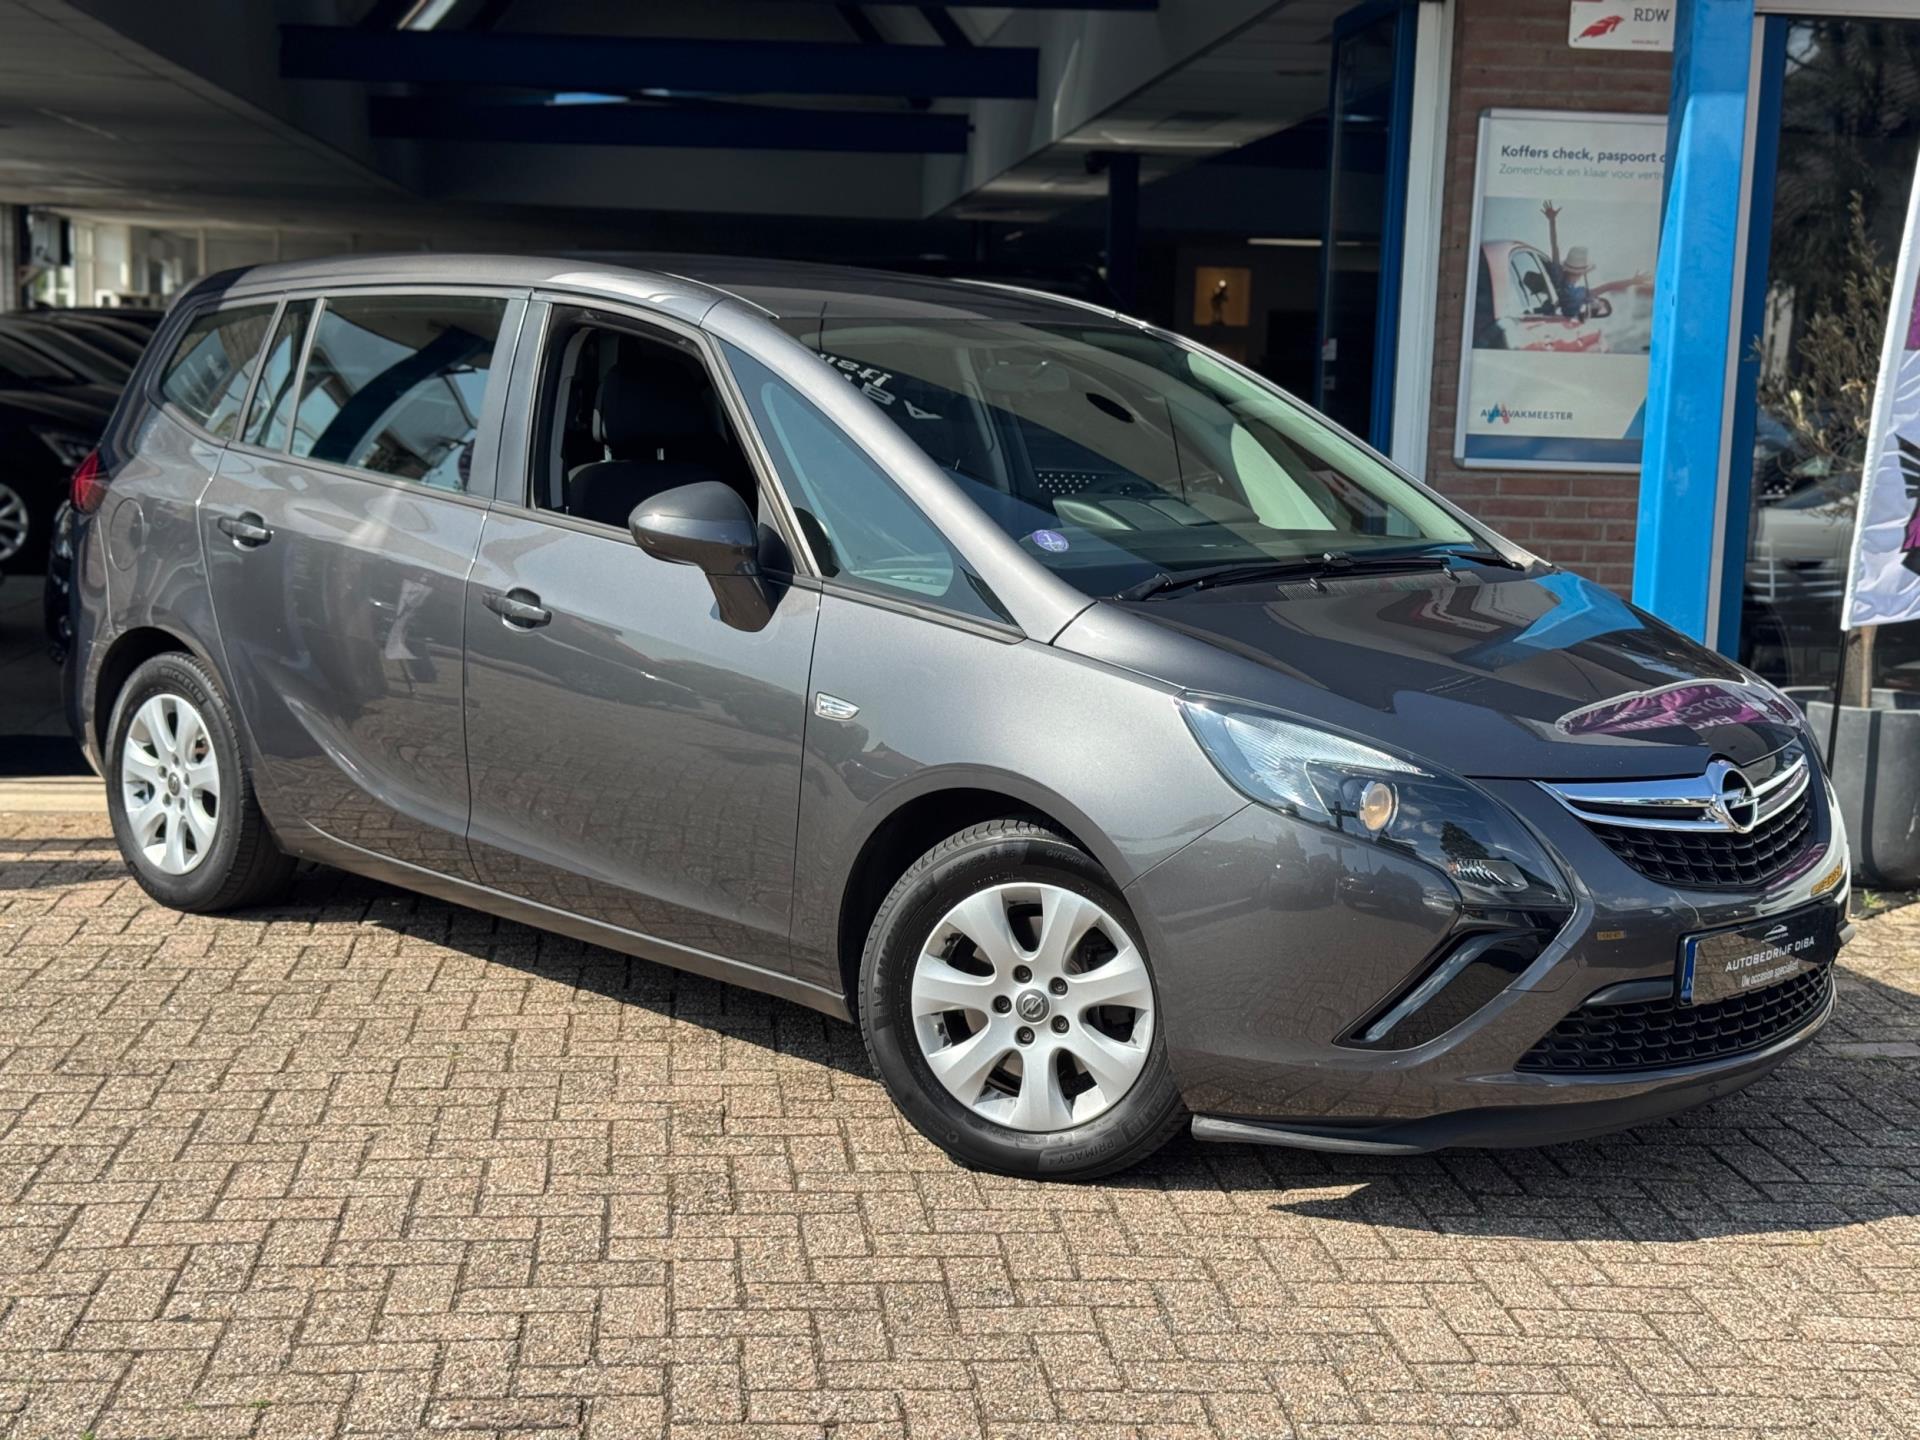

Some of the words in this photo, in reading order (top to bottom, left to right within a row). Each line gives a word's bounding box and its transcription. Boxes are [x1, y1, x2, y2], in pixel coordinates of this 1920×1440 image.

[1633, 8, 1670, 22] RDW
[1501, 145, 1549, 159] Koffers
[1552, 147, 1594, 162] check,
[1597, 151, 1657, 164] paspoort
[1499, 163, 1564, 176] Zomercheck
[1567, 168, 1581, 177] en
[1611, 170, 1635, 179] voor
[1725, 943, 1793, 973] AUTOBEDRIJF
[1795, 936, 1815, 952] DIBA
[1059, 1139, 1114, 1165] PRIMACY
